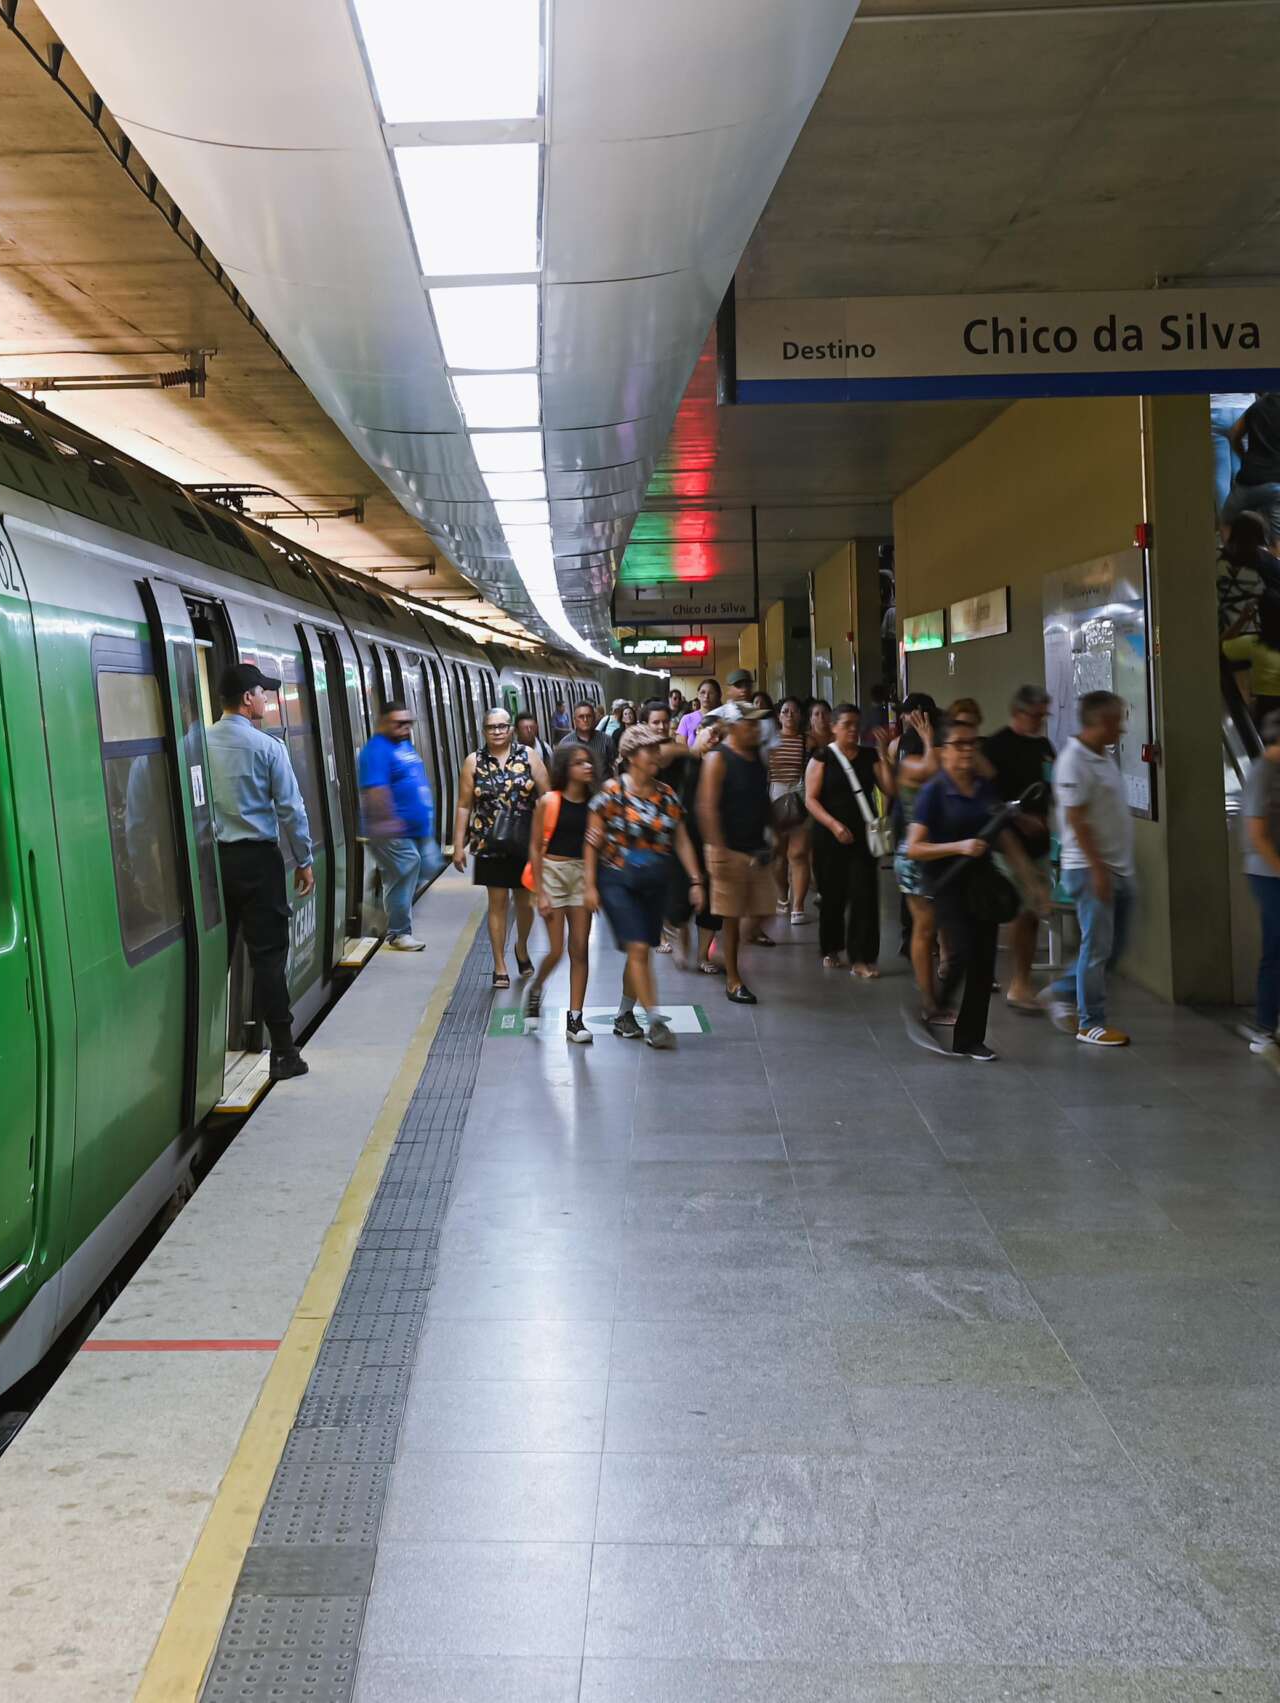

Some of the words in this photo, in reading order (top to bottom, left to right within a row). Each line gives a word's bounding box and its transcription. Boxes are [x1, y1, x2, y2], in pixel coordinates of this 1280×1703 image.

[782, 340, 876, 361] Destino
[963, 316, 1078, 356] Chico
[1093, 314, 1144, 353] da
[1159, 312, 1261, 352] Silva
[672, 604, 701, 616] Chico
[704, 602, 718, 614] da
[720, 602, 746, 614] Silva
